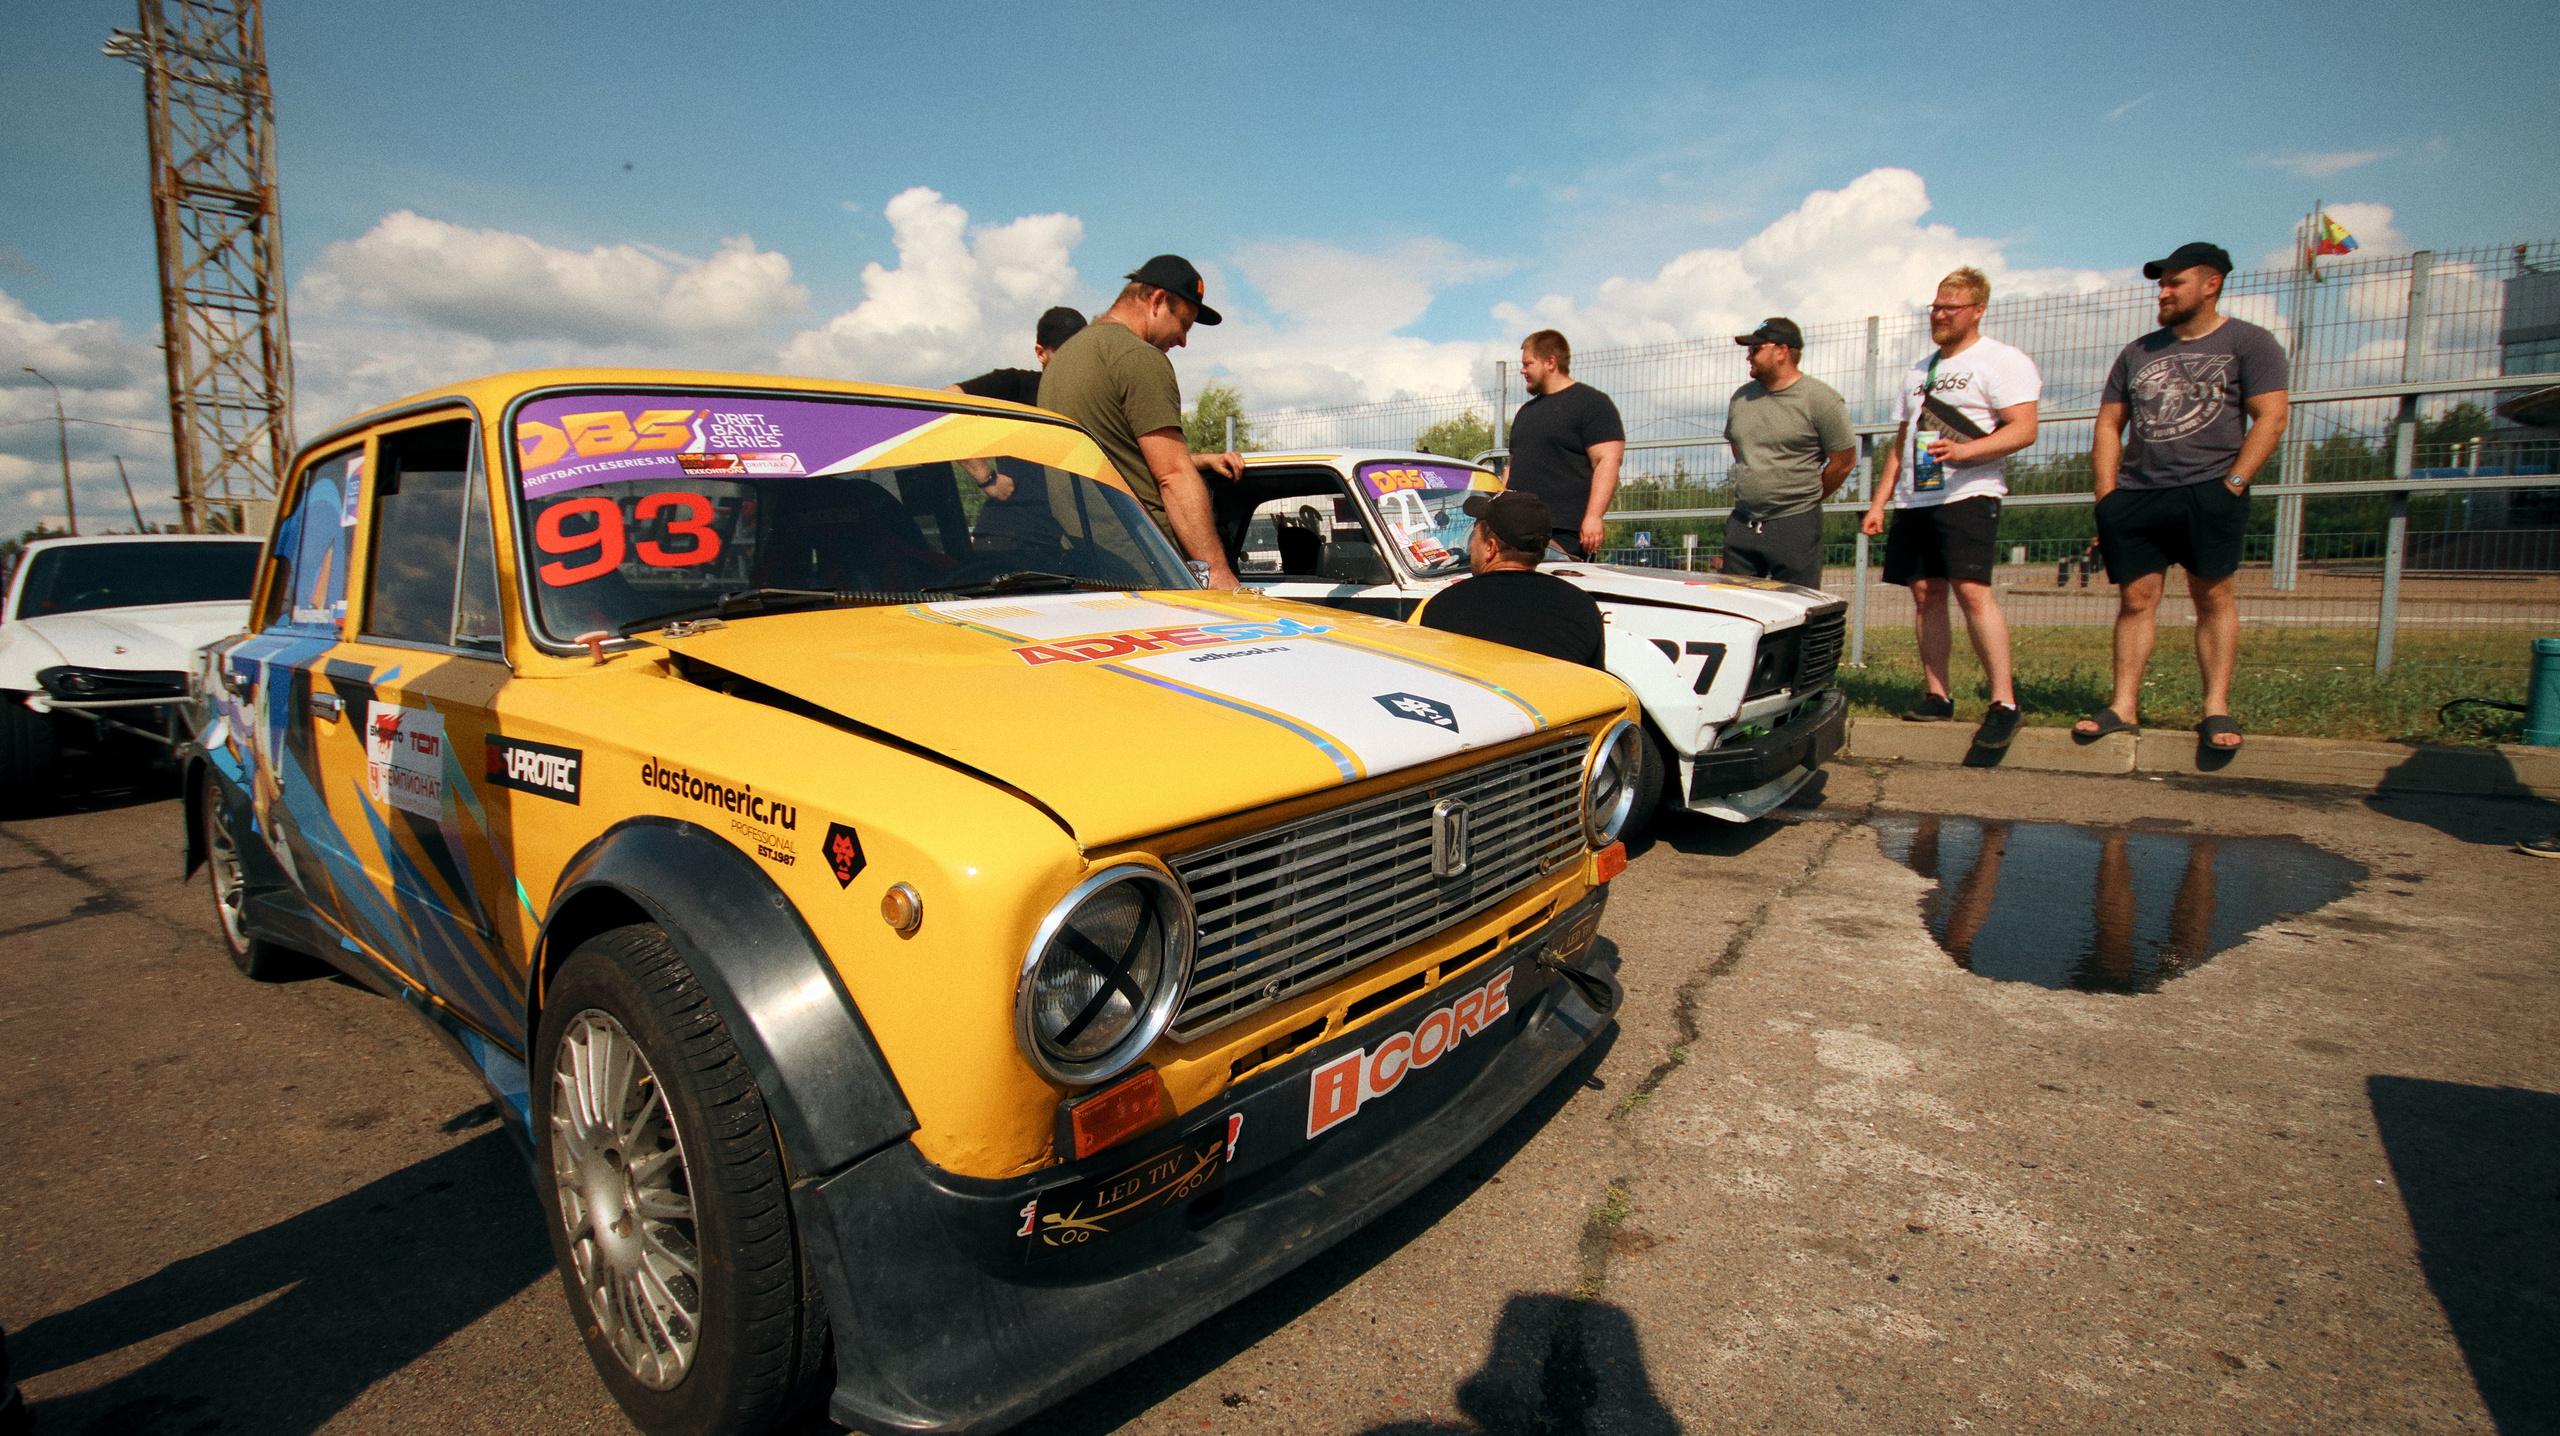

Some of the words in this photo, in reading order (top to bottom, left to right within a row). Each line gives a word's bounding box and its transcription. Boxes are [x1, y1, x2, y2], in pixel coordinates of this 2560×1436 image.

[710, 424, 785, 436] BATTLE
[713, 412, 766, 425] DRIFT
[517, 409, 695, 471] DBS
[709, 435, 782, 448] SERIES
[1368, 469, 1426, 494] DBS
[534, 491, 721, 588] 93
[1010, 617, 1338, 667] ADHESOL
[1188, 646, 1292, 663] adhesol.ru
[641, 755, 796, 831] elastomeric.ru
[730, 819, 796, 854] PROFESSIONAL
[757, 844, 796, 867] EST.1987
[1096, 1177, 1140, 1208] LED
[1149, 1153, 1184, 1186] TIV
